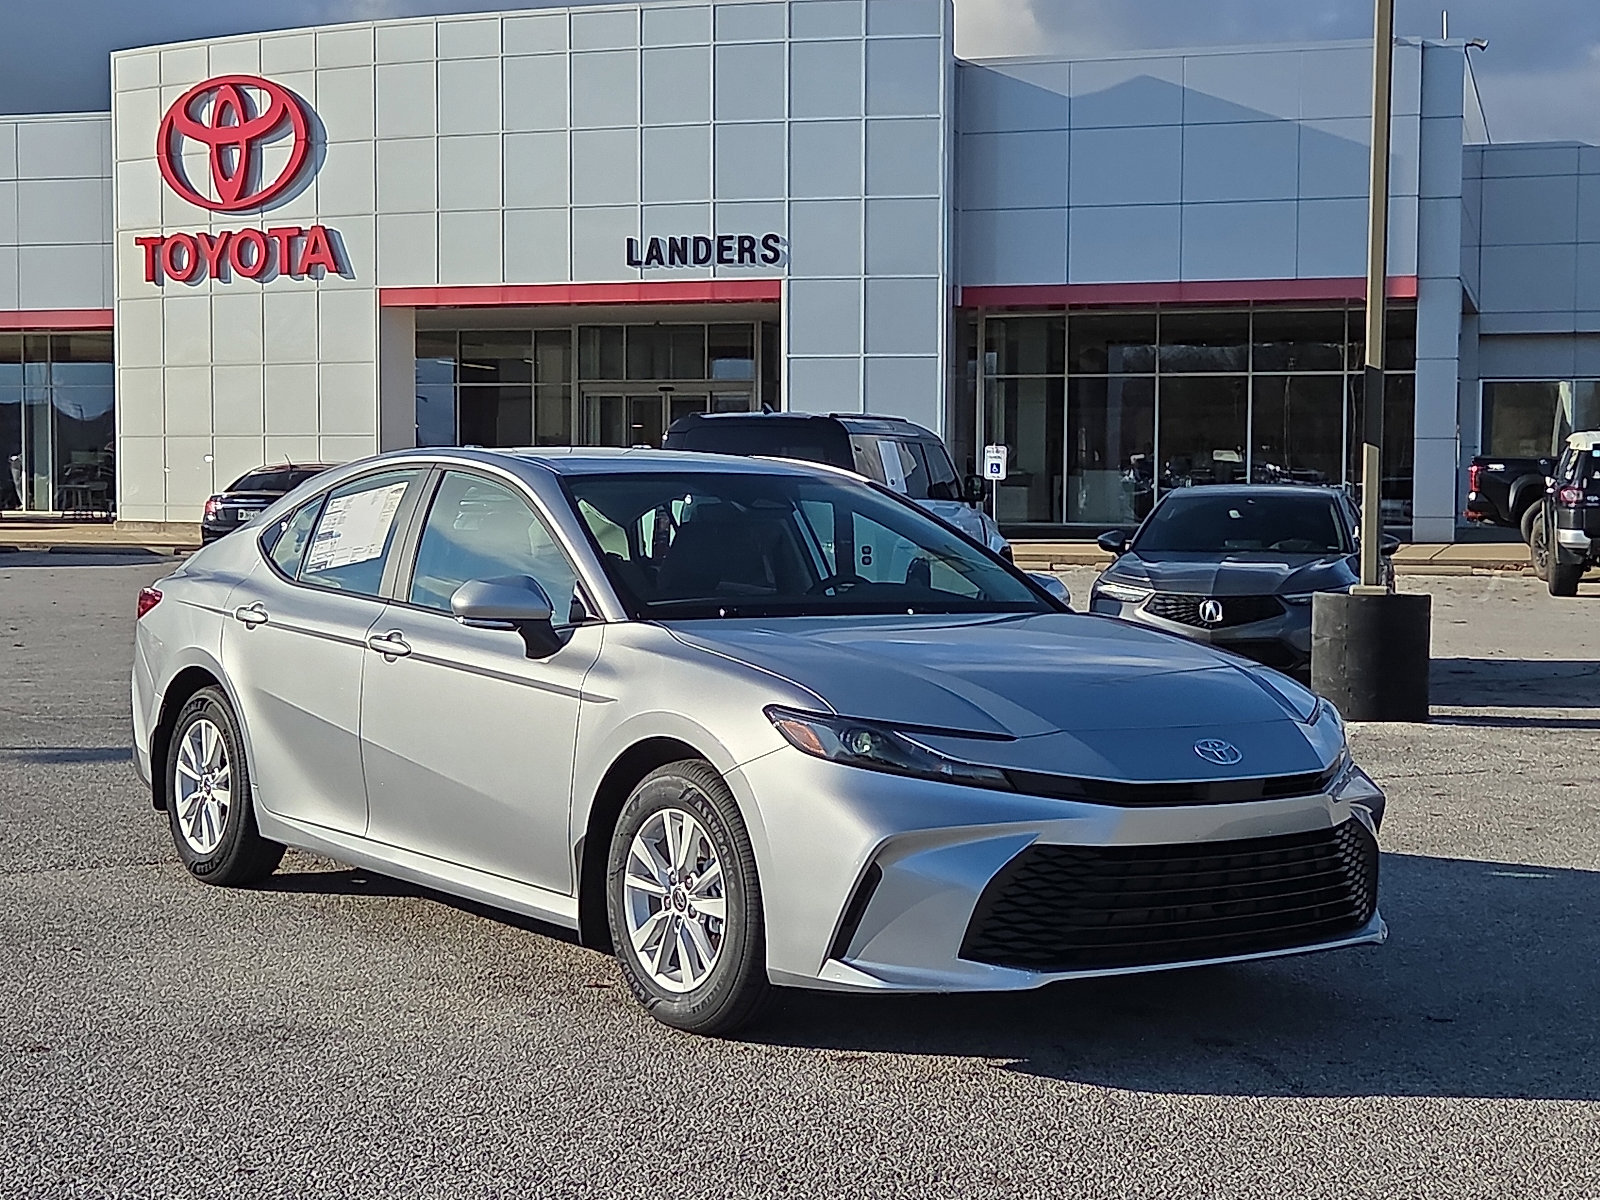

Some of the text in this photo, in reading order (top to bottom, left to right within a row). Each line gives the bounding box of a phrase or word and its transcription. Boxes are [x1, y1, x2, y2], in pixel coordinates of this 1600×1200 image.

[135, 225, 339, 283] TOYOTA
[626, 233, 781, 266] LANDERS
[694, 799, 736, 884] ASSURANC
